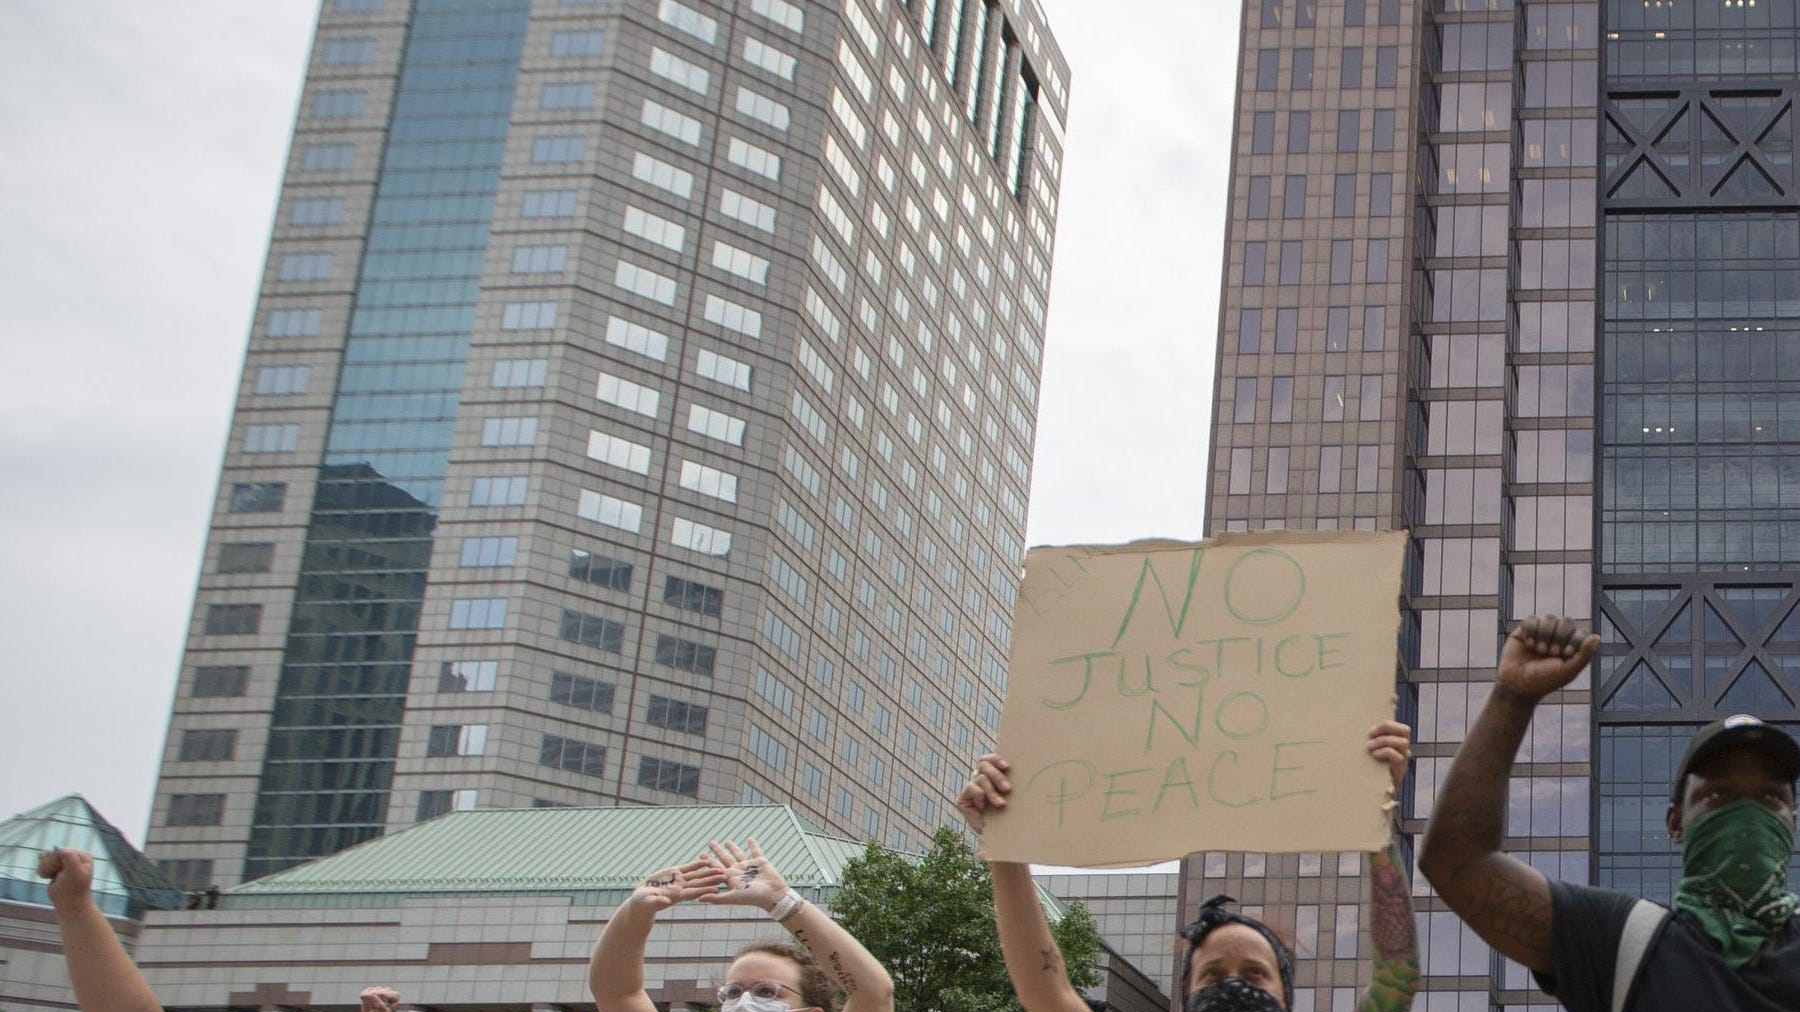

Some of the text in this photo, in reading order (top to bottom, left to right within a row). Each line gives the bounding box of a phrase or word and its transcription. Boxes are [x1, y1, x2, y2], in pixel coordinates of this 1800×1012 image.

[1112, 547, 1305, 649] NO
[1042, 632, 1351, 709] JUSTICE
[1146, 686, 1269, 753] NO
[1027, 741, 1328, 827] PEACE
